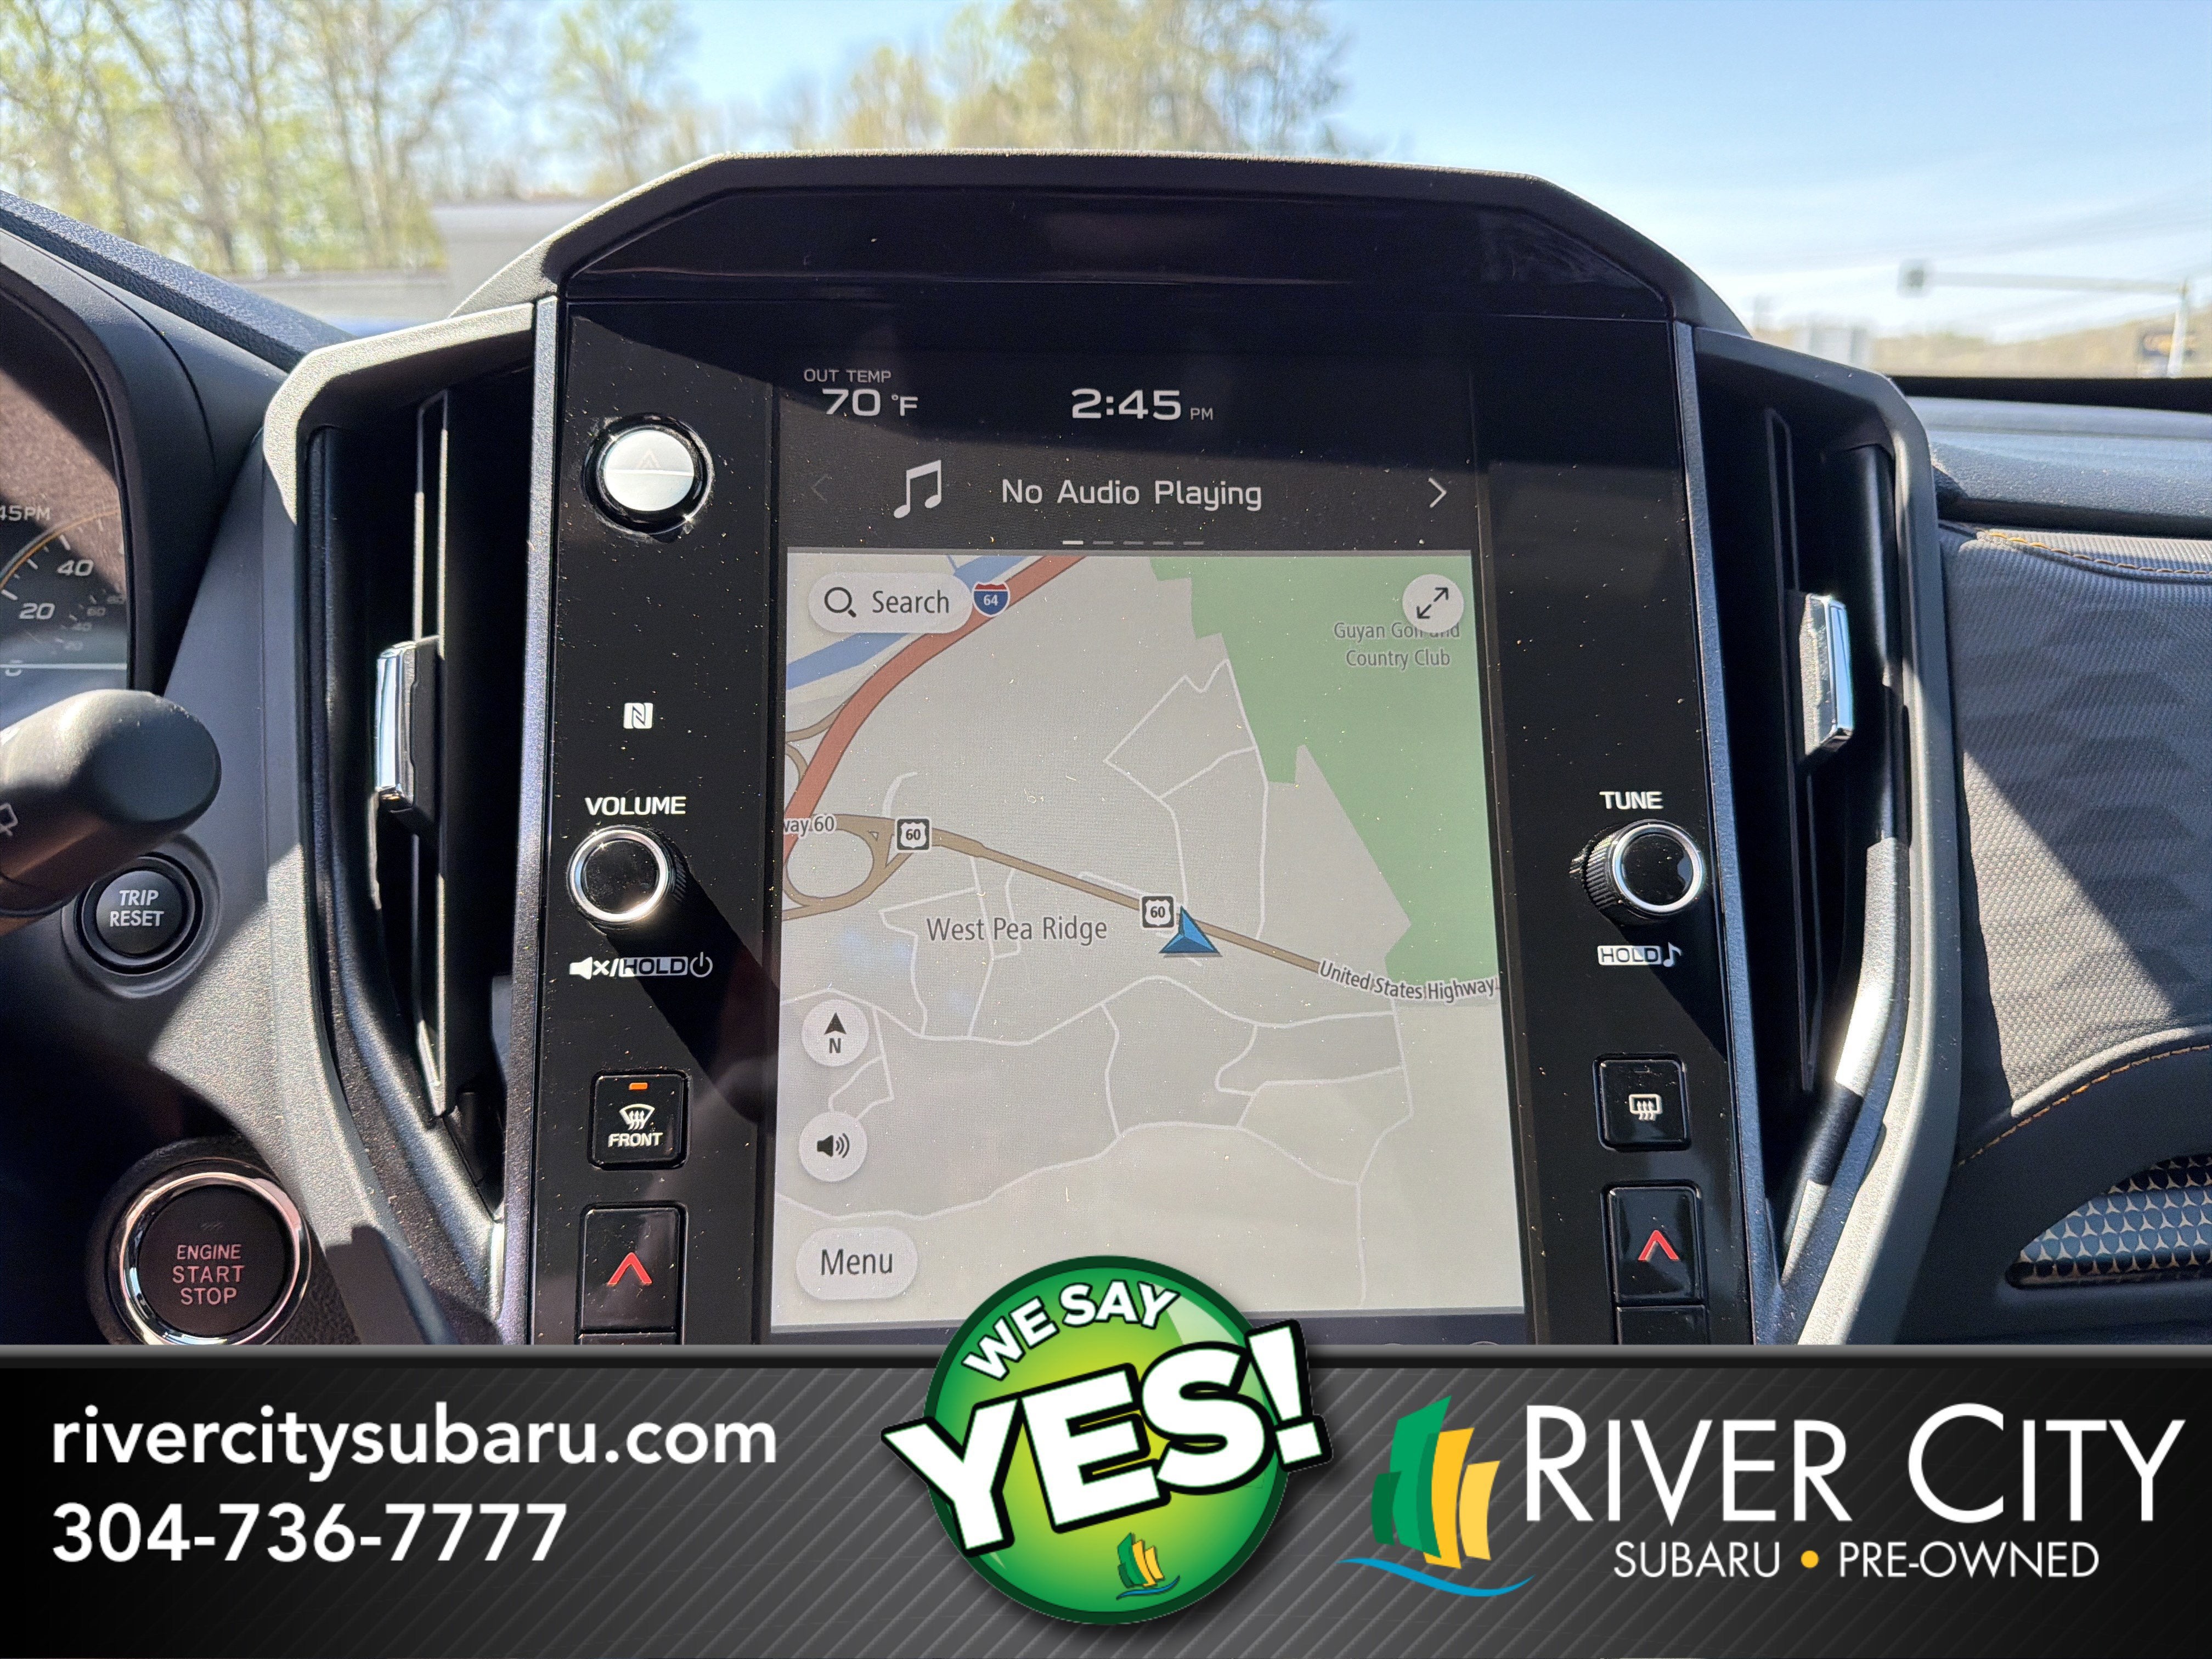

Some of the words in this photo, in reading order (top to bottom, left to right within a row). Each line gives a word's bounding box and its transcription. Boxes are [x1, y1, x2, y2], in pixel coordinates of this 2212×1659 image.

[804, 368, 839, 383] OUT
[846, 370, 891, 383] TEMP
[822, 388, 881, 416] 70
[1071, 387, 1182, 421] 2:45
[1190, 407, 1214, 421] PM
[1002, 479, 1043, 504] No
[1057, 479, 1140, 505] Audio
[1154, 480, 1262, 511] Playing
[57, 559, 94, 577] 40
[872, 589, 950, 613] Search
[983, 594, 998, 606] 64
[19, 603, 55, 620] 20
[1334, 622, 1385, 644] Guyan
[1346, 650, 1408, 671] Country
[1414, 648, 1451, 666] Club
[585, 796, 687, 816] VOLUME
[1599, 791, 1664, 810] TUNE
[814, 816, 834, 832] 60
[906, 828, 921, 840] 60
[119, 889, 159, 906] TRIP
[110, 910, 165, 927] RESET
[1150, 906, 1166, 918] 60
[926, 918, 985, 941] West
[993, 918, 1032, 940] Pea
[1043, 916, 1108, 946] Ridge
[1599, 947, 1661, 964] HOLD
[1320, 960, 1372, 990] United
[1374, 977, 1422, 999] States
[1428, 979, 1496, 1003] Highway
[828, 1039, 842, 1054] N
[608, 1132, 663, 1148] FRONT
[177, 1244, 242, 1260] ENGINE
[821, 1248, 893, 1276] Menu
[172, 1265, 245, 1284] START
[180, 1286, 238, 1306] STOP
